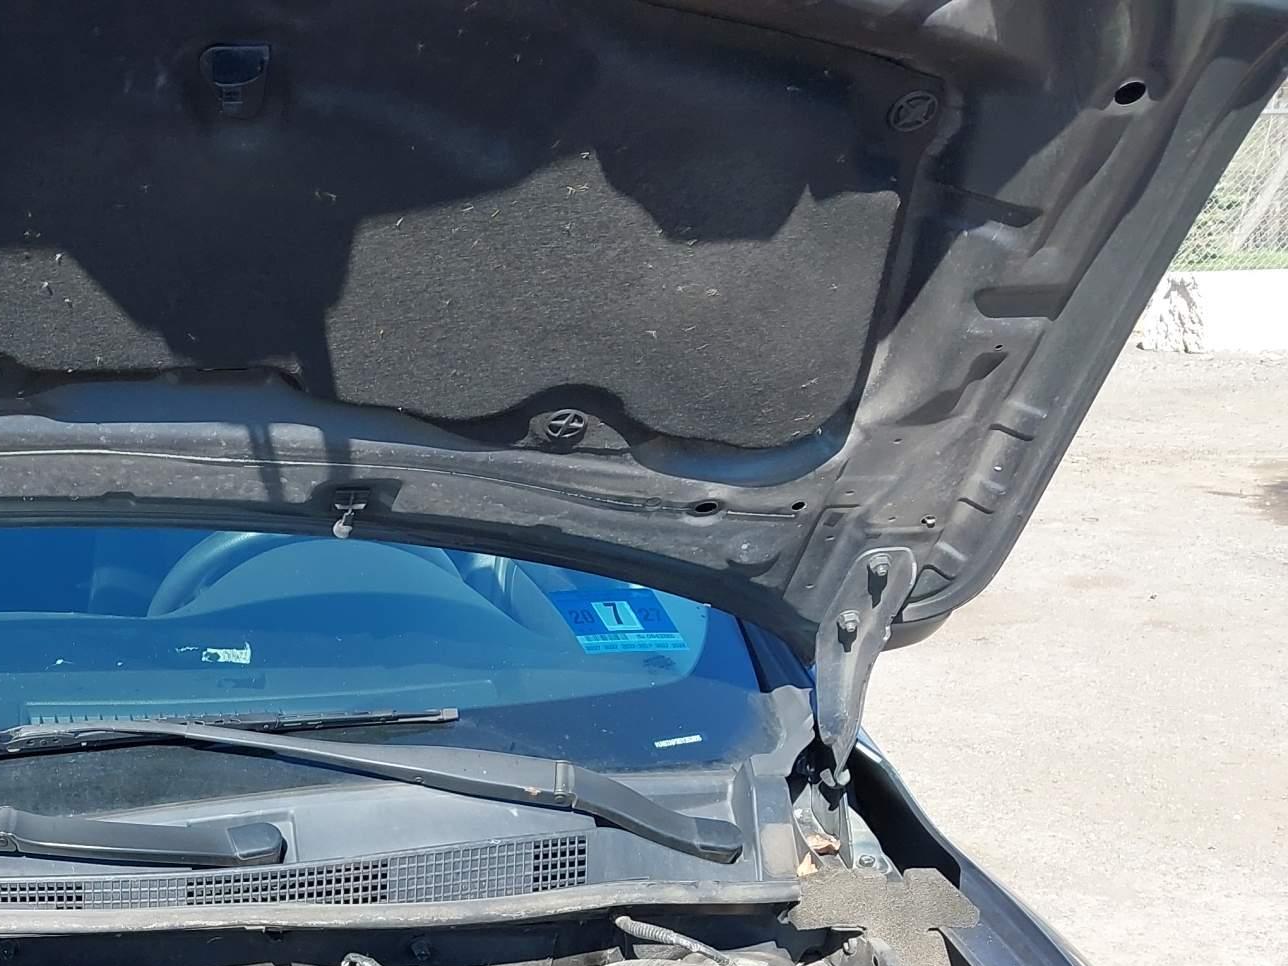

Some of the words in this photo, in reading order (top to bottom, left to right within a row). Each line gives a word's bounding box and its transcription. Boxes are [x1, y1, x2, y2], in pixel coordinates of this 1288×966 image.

[569, 609, 595, 625] 20
[602, 602, 624, 625] 7
[638, 608, 663, 622] 27
